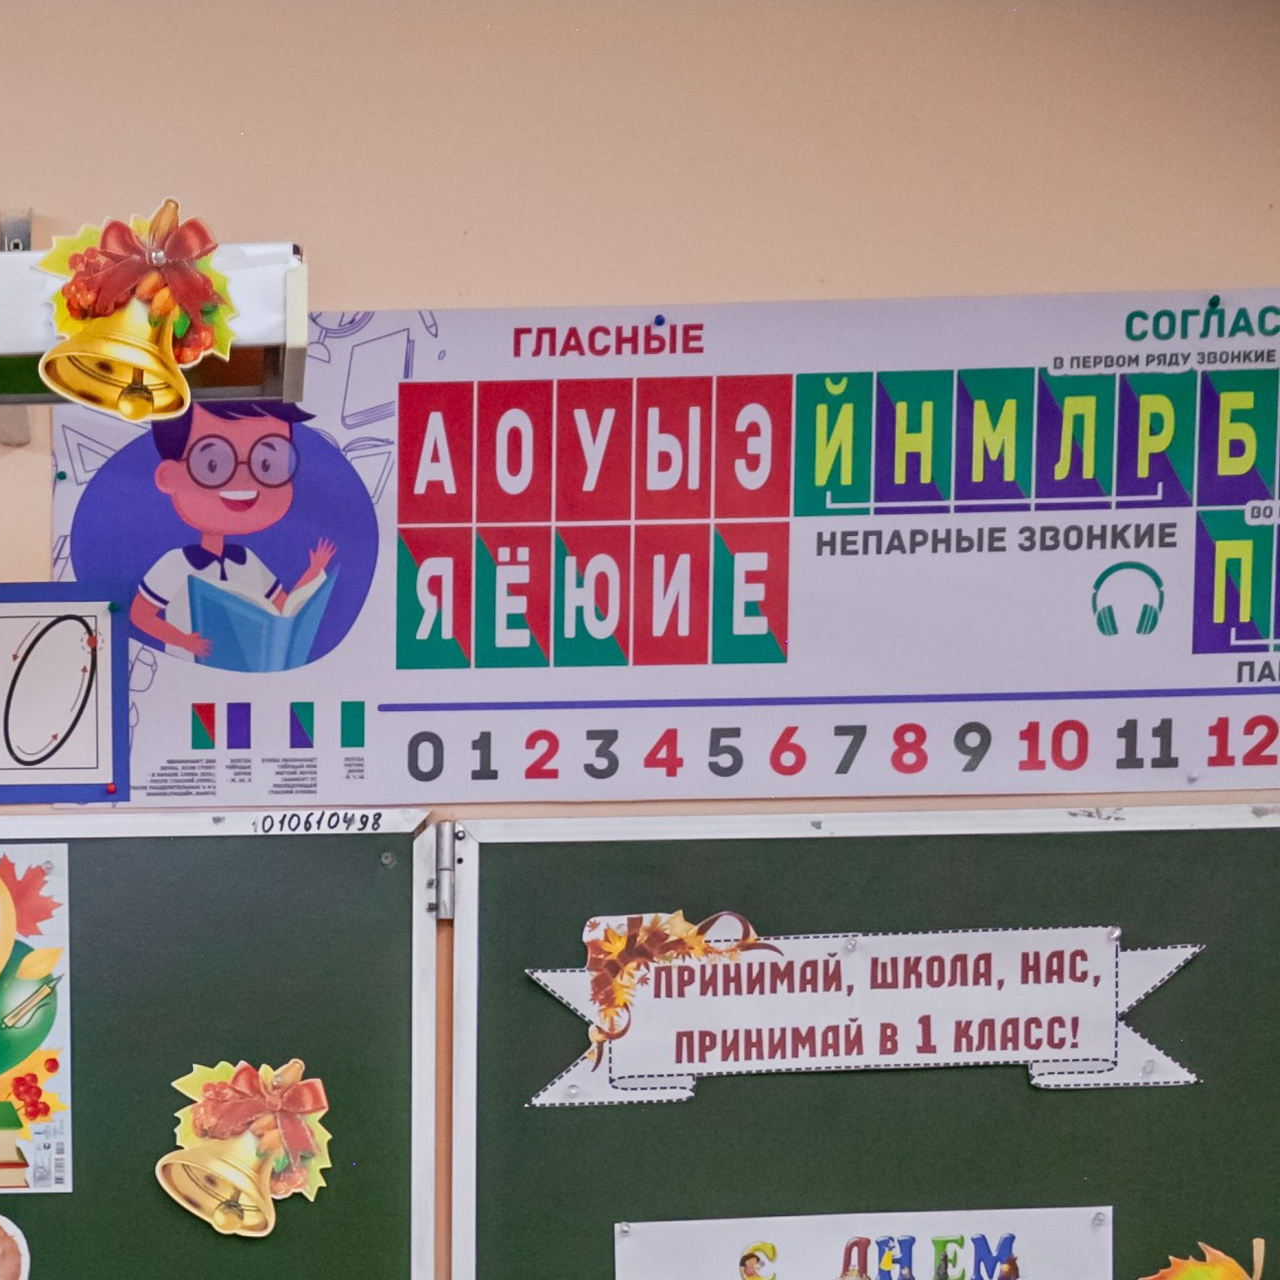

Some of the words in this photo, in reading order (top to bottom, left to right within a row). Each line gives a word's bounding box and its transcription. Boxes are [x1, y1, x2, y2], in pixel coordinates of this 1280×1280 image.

[512, 323, 704, 358] ГЛАСНЫЕ
[1125, 305, 1280, 342] СОГЛАС
[1053, 356, 1064, 370] В
[1070, 354, 1140, 369] ПЕРВОМ
[1145, 352, 1192, 367] РЯДУ
[1196, 349, 1277, 365] ЗВОНКИЕ
[414, 411, 457, 494] А
[495, 408, 534, 495] О
[573, 408, 616, 492] У
[646, 405, 701, 491] Ы
[734, 402, 773, 490] Э
[815, 376, 855, 487] Й
[894, 400, 934, 485] Н
[971, 398, 1017, 482] М
[1054, 395, 1098, 480] Л
[1137, 393, 1176, 478] Р
[1217, 391, 1258, 476] Б
[1250, 505, 1274, 519] ВО
[816, 526, 1007, 557] НЕПАРНЫЕ
[1018, 521, 1178, 552] ЗВОНКИЕ
[415, 557, 454, 640] Я
[495, 546, 531, 648] Ё
[564, 553, 621, 640] Ю
[652, 553, 691, 637] И
[733, 552, 769, 636] Е
[1213, 539, 1254, 624] П
[1237, 660, 1280, 684] ПА
[407, 730, 444, 782] 0
[470, 730, 499, 780] 1
[524, 729, 560, 779] 2
[583, 728, 620, 779] 3
[643, 728, 684, 778] 4
[707, 726, 744, 778] 5
[769, 725, 807, 777] 6
[833, 724, 868, 775] 7
[890, 722, 930, 774] 8
[952, 721, 993, 773] 9
[1018, 719, 1089, 771] 10
[1115, 718, 1179, 769] 11
[1206, 715, 1280, 767] 12
[653, 951, 855, 999] ПРИНИМАЙ,
[869, 951, 1005, 991] ШКОЛА,
[1020, 948, 1101, 988] НАС,
[674, 1017, 864, 1064] ПРИНИМАЙ
[878, 1022, 899, 1056] В
[915, 1014, 937, 1055] 1
[953, 1016, 1080, 1054] КЛАСС!
